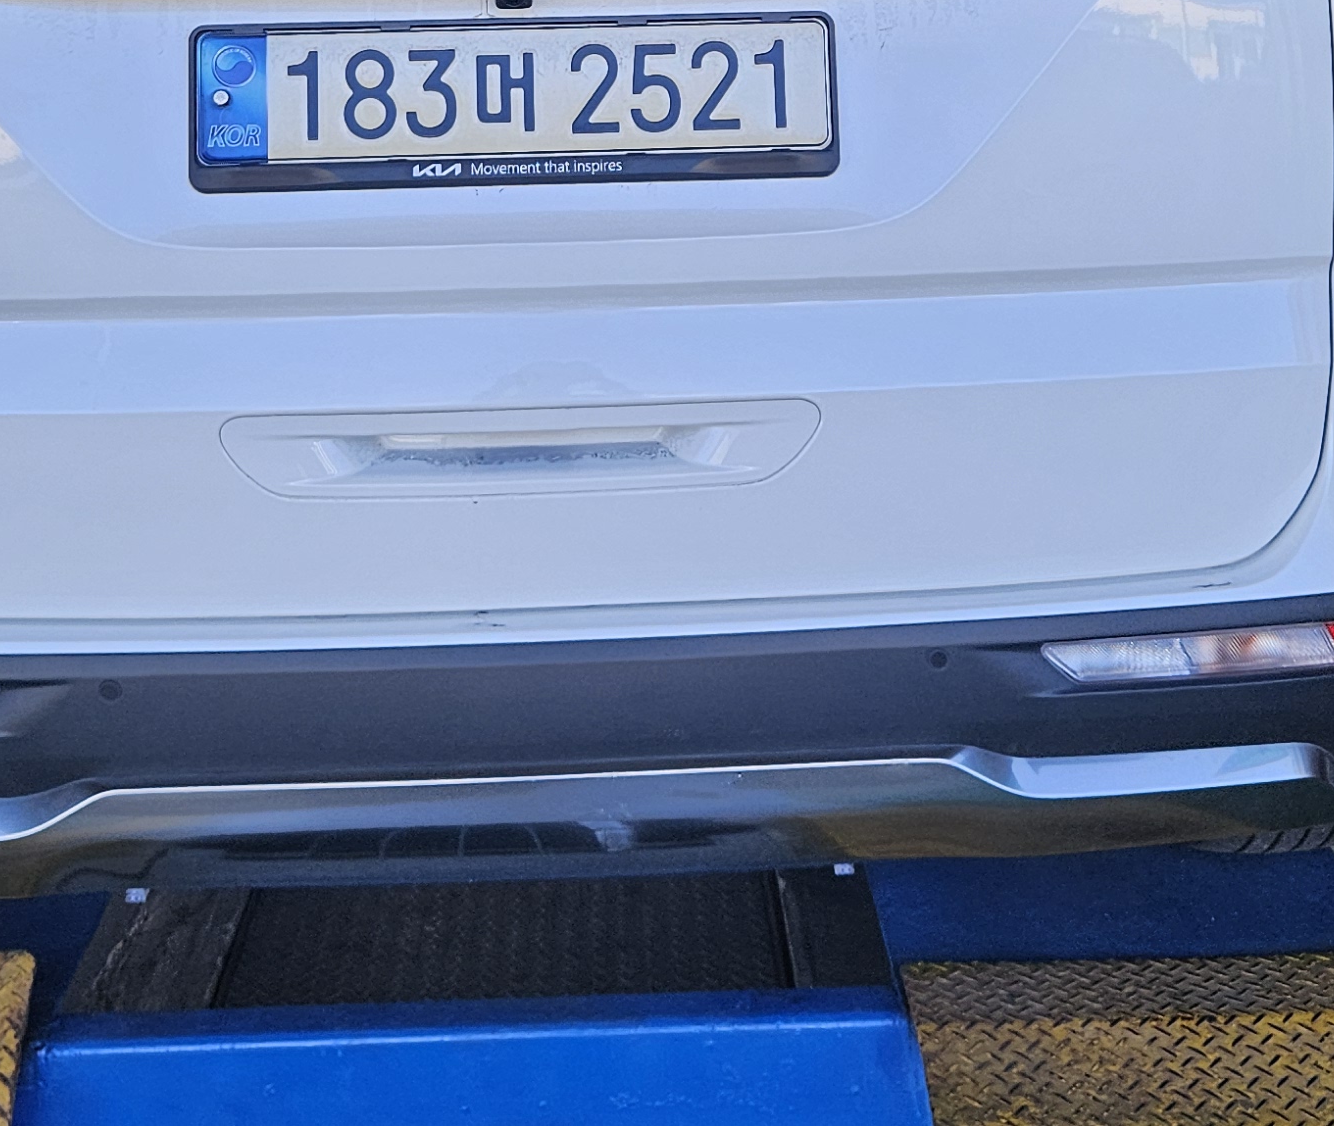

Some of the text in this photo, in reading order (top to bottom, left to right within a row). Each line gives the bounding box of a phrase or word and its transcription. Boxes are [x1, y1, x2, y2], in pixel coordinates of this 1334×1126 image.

[286, 39, 788, 141] 183머 2521
[207, 124, 262, 148] KOR
[412, 158, 623, 177] KIA Movement that inspires
